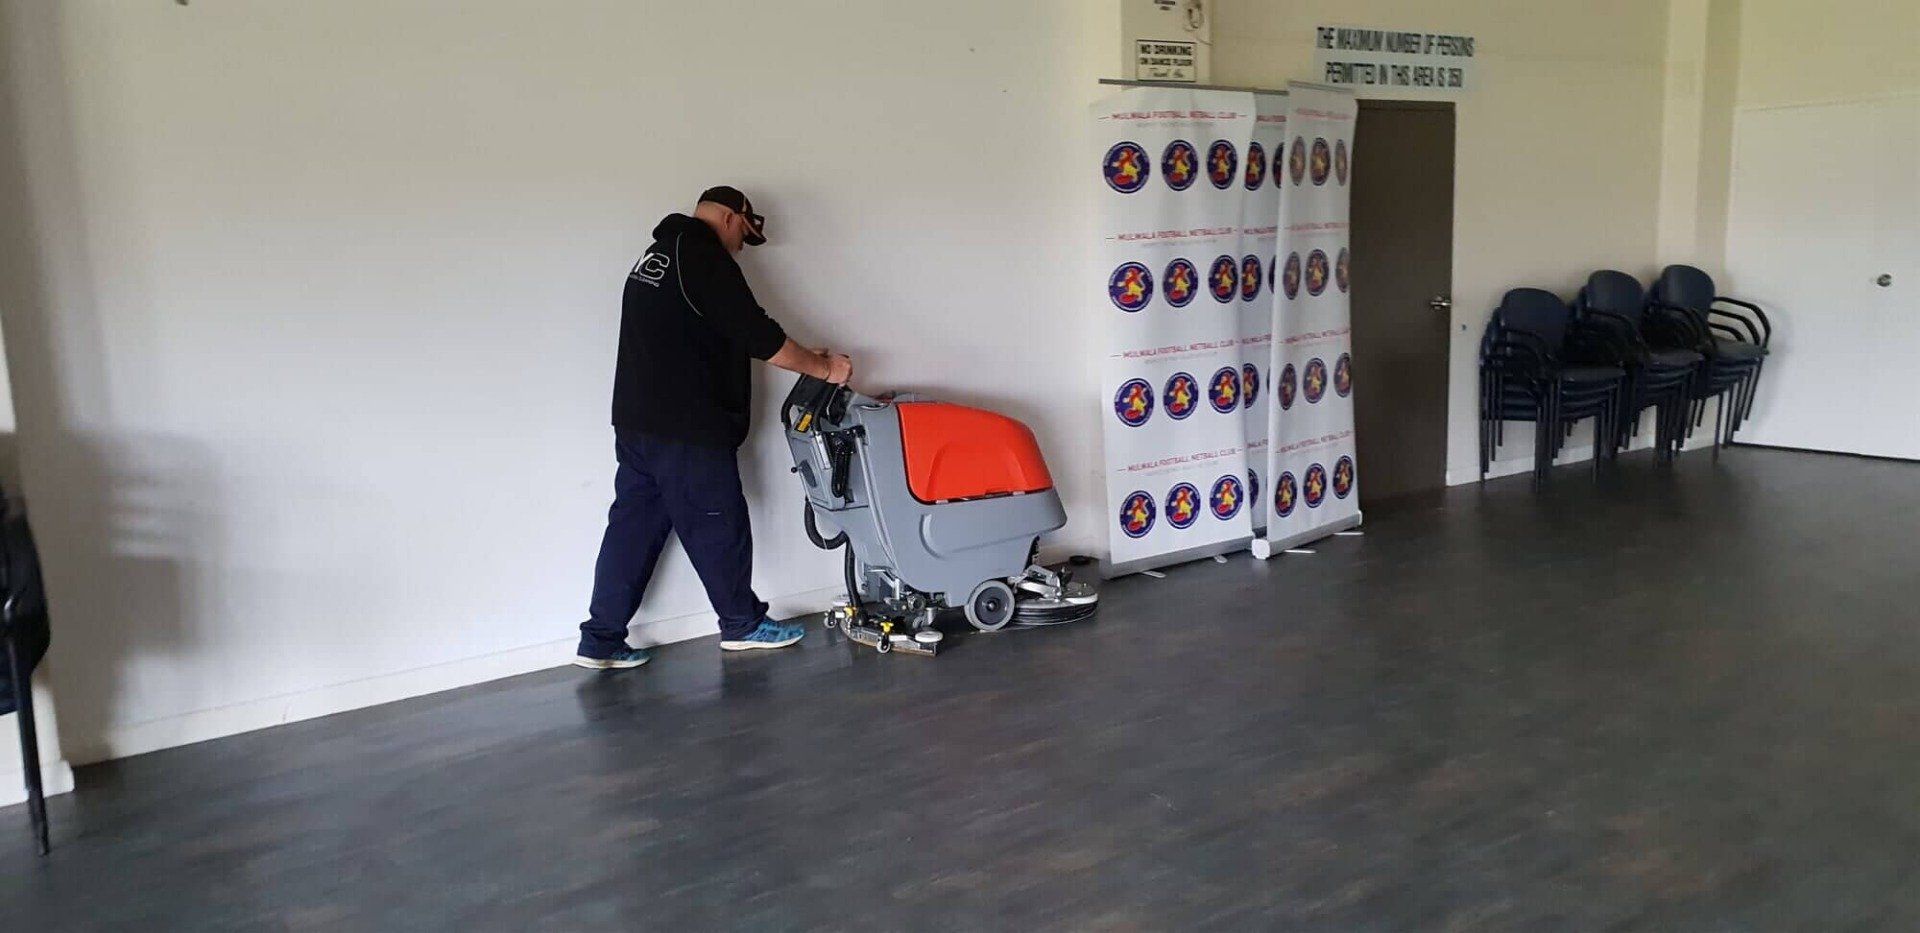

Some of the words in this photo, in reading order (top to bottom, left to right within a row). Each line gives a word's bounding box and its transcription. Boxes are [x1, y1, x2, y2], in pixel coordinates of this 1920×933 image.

[1140, 44, 1151, 54] NO
[1153, 45, 1192, 56] DRINKING
[1317, 26, 1335, 49] THE
[1337, 28, 1384, 52] MAXIMUM
[1386, 32, 1422, 54] NUMBER
[1424, 34, 1436, 54] OF
[1437, 35, 1475, 57] PERSONS
[1325, 61, 1375, 85] PERMITTED
[1379, 64, 1388, 85] IN
[1391, 65, 1411, 86] THIS
[1413, 66, 1434, 87] AREA
[1437, 67, 1445, 88] IS
